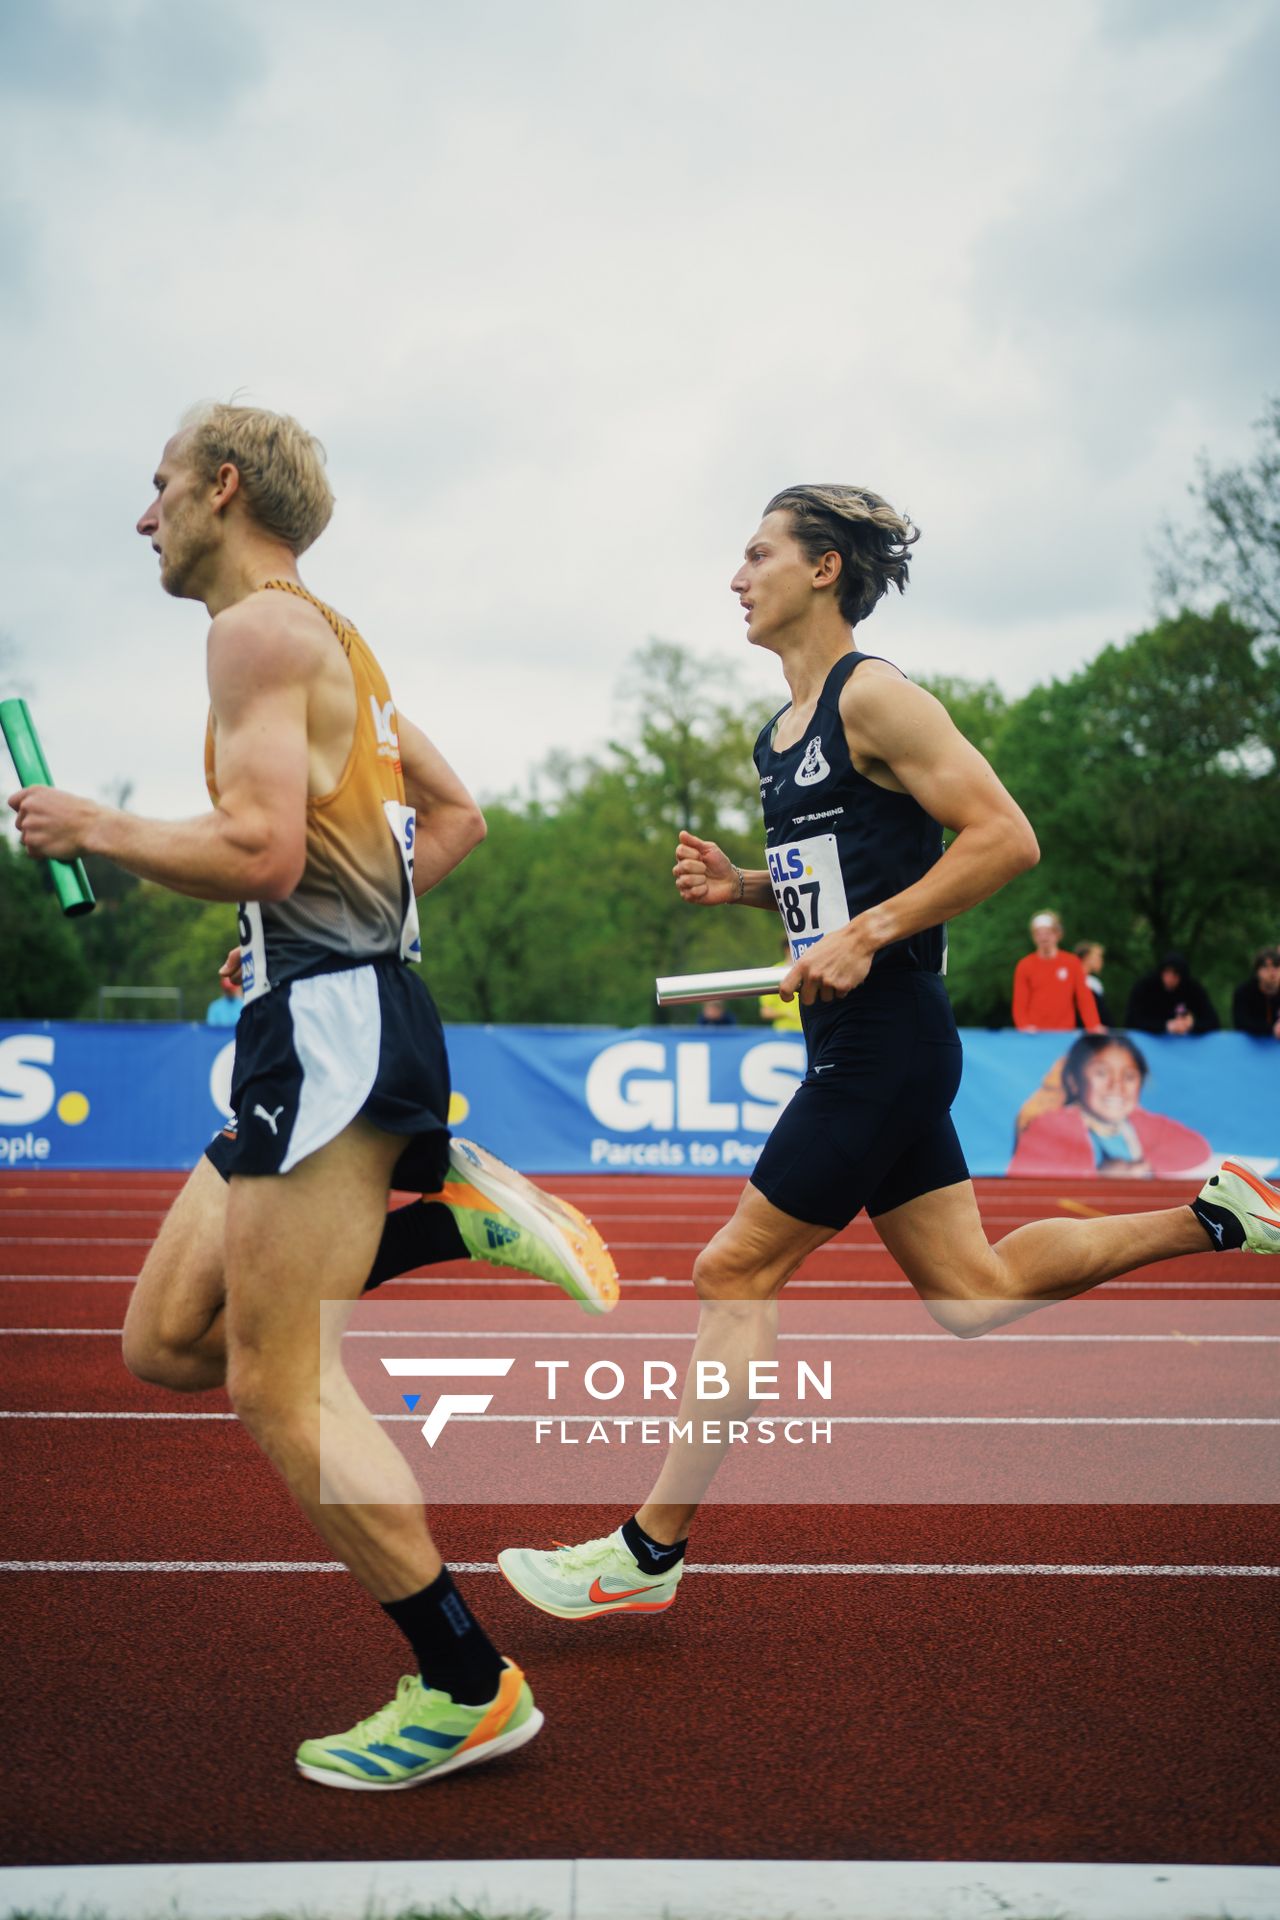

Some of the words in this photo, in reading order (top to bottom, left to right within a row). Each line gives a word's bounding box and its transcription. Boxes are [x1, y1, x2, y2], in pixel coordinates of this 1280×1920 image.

[585, 1040, 808, 1133] GLS
[591, 1138, 684, 1165] Parcels
[690, 1141, 718, 1165] to
